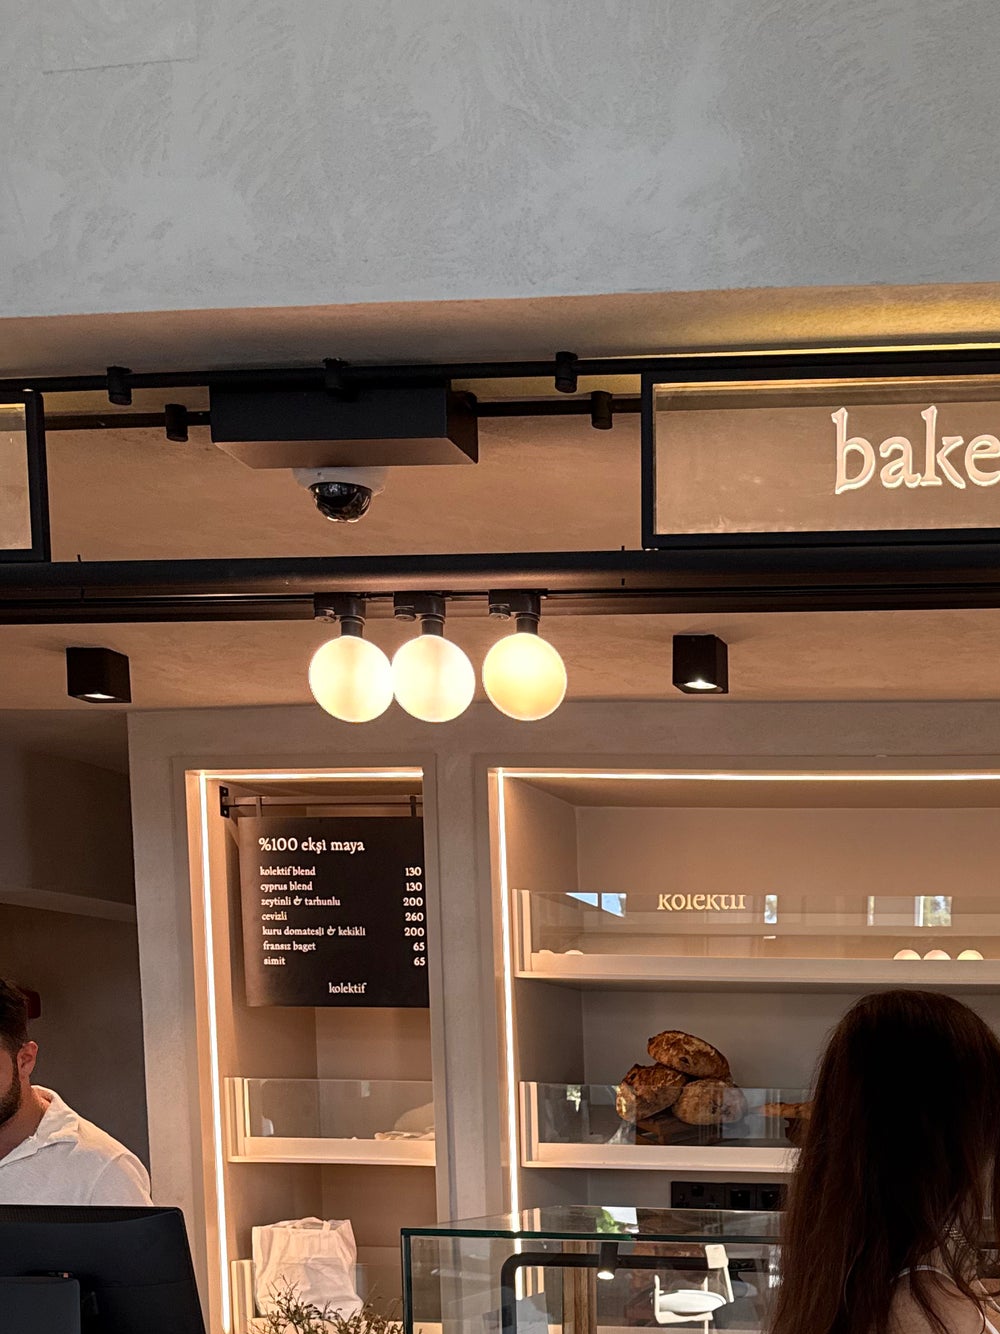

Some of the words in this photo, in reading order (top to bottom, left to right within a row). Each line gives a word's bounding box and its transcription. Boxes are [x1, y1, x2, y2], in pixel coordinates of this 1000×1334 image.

[258, 837, 298, 852] %100
[301, 836, 327, 855] ekşi
[330, 840, 365, 855] maya
[259, 866, 292, 876] kolektif
[292, 865, 316, 876] blend
[405, 866, 422, 877] 130
[260, 883, 287, 893] cyprus
[289, 881, 313, 891] blend
[406, 882, 423, 892] 130
[260, 896, 292, 908] zeytinli
[293, 895, 303, 906] &
[304, 896, 341, 906] tarhunlu
[402, 897, 424, 907] 200
[261, 910, 288, 921] cevizli
[404, 912, 424, 922] 260
[262, 926, 282, 936] kuru
[326, 925, 336, 936] &
[337, 926, 366, 936] kekikli
[403, 927, 425, 937] 200
[292, 941, 316, 952] baget
[413, 942, 425, 952] 65
[263, 956, 286, 966] simit
[413, 957, 426, 967] 65
[328, 982, 368, 995] kolektif
